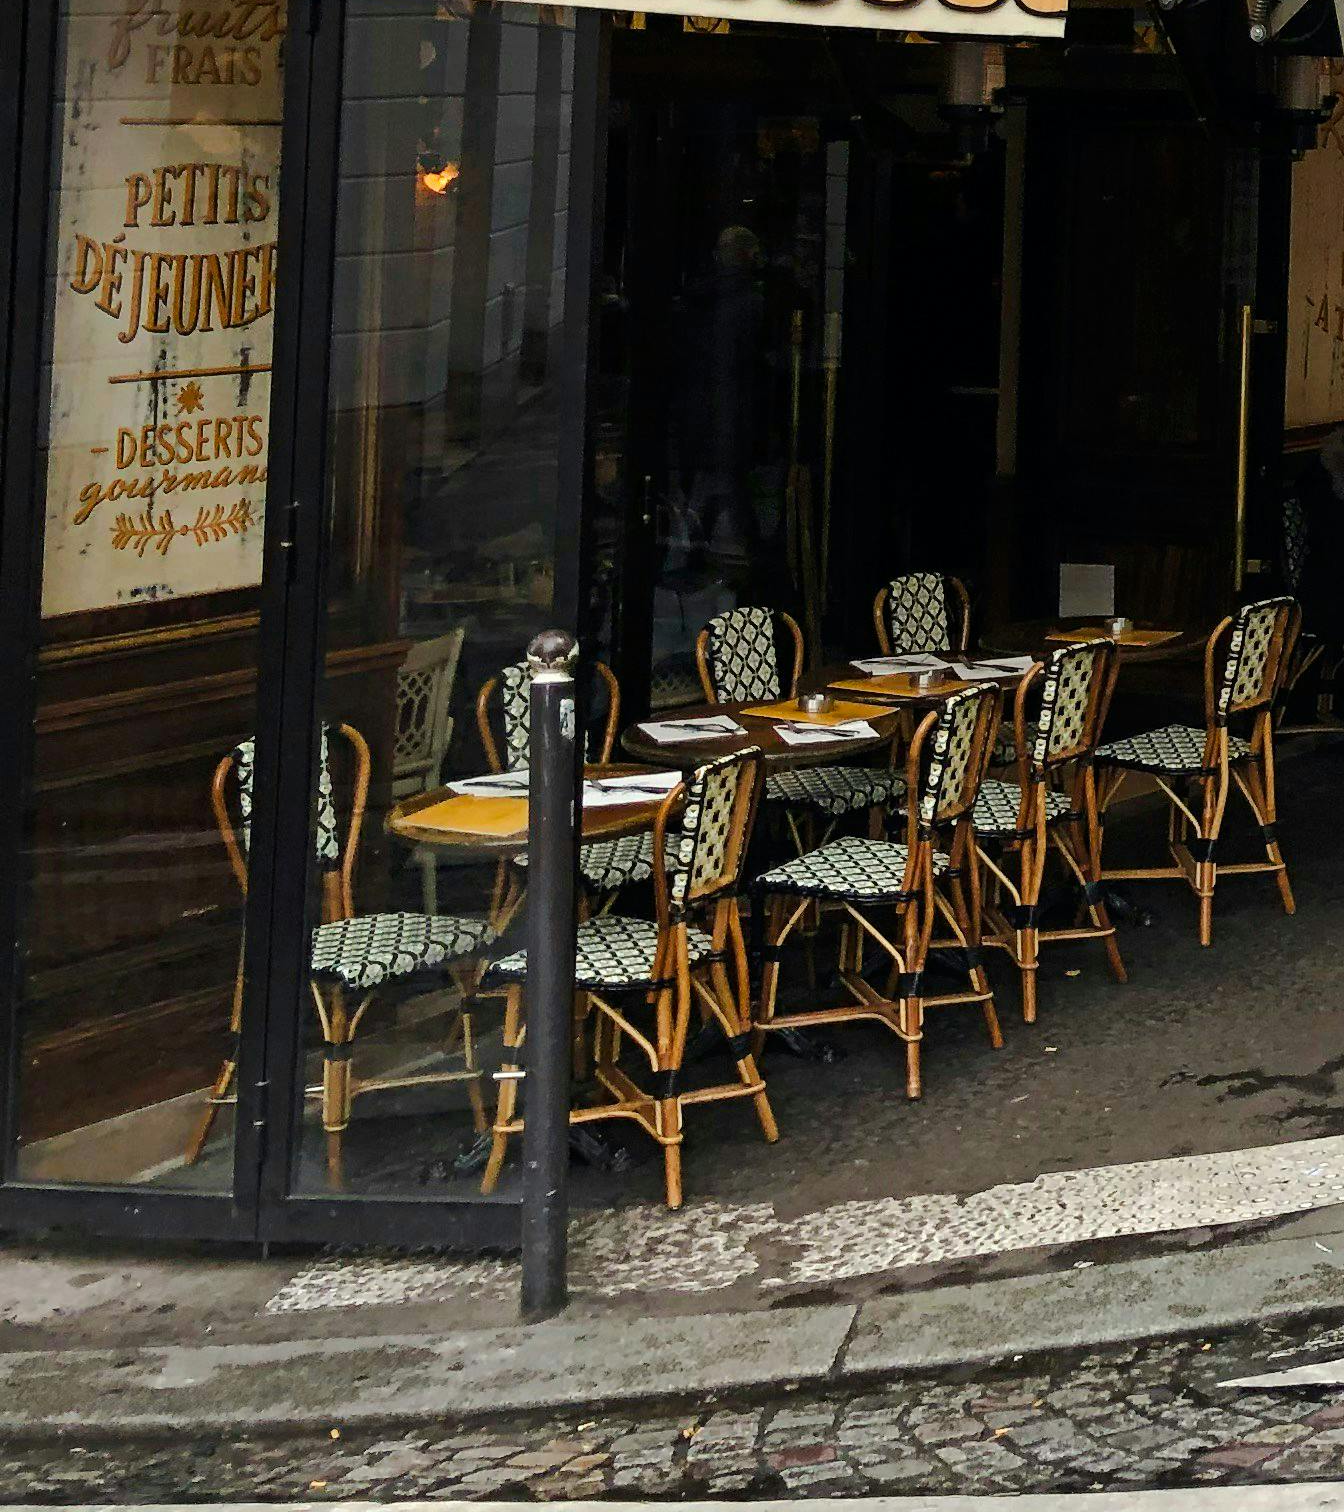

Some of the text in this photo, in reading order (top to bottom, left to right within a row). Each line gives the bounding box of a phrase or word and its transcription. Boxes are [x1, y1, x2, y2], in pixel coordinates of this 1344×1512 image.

[145, 43, 263, 86] FRAIS
[123, 162, 272, 228] PETITS
[115, 414, 264, 470] DESSERTS
